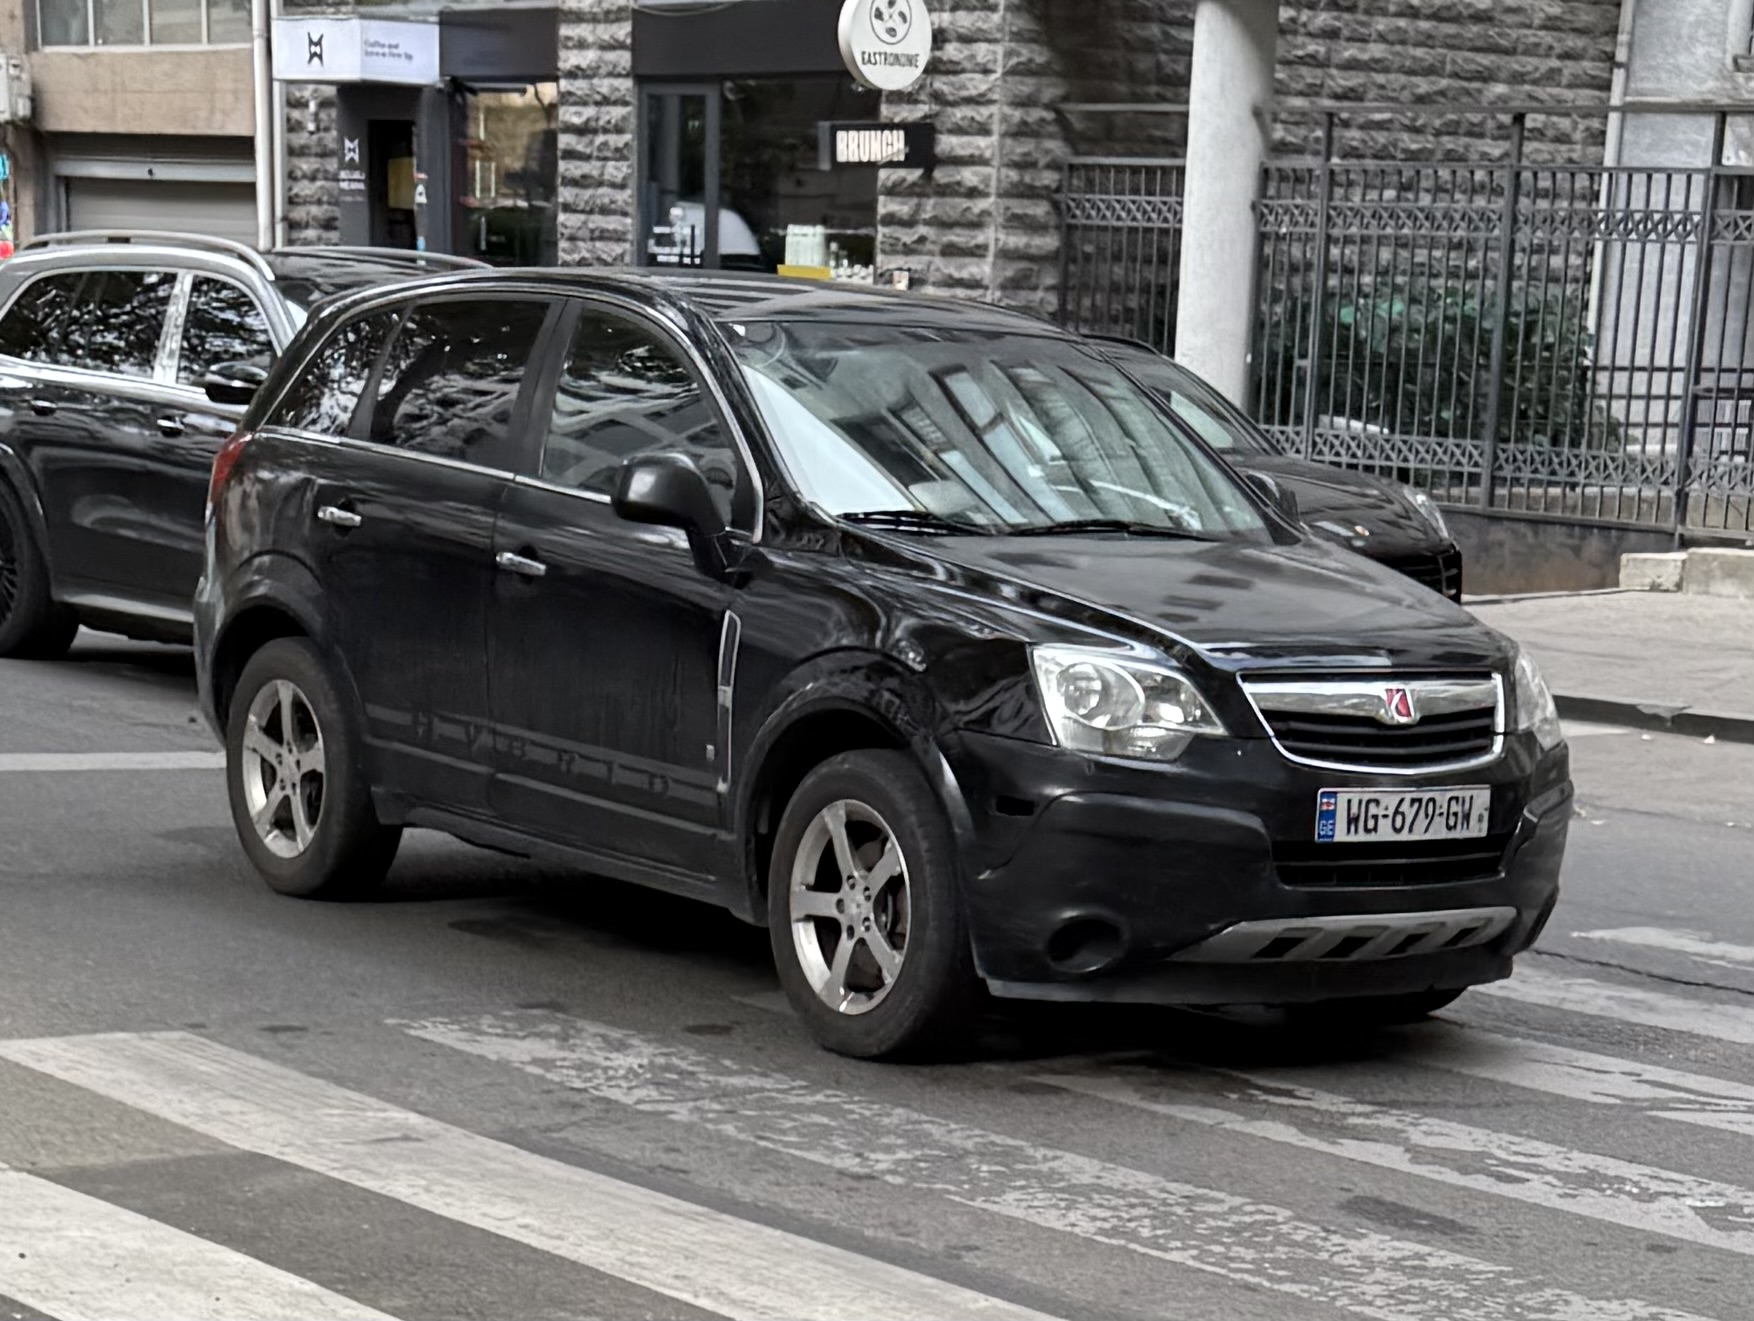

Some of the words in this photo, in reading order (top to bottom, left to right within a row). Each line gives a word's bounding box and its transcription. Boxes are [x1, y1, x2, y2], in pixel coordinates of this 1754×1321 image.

[836, 130, 905, 163] BRUNCH
[1319, 820, 1335, 836] GE
[1346, 794, 1474, 836] WG-679-GW
